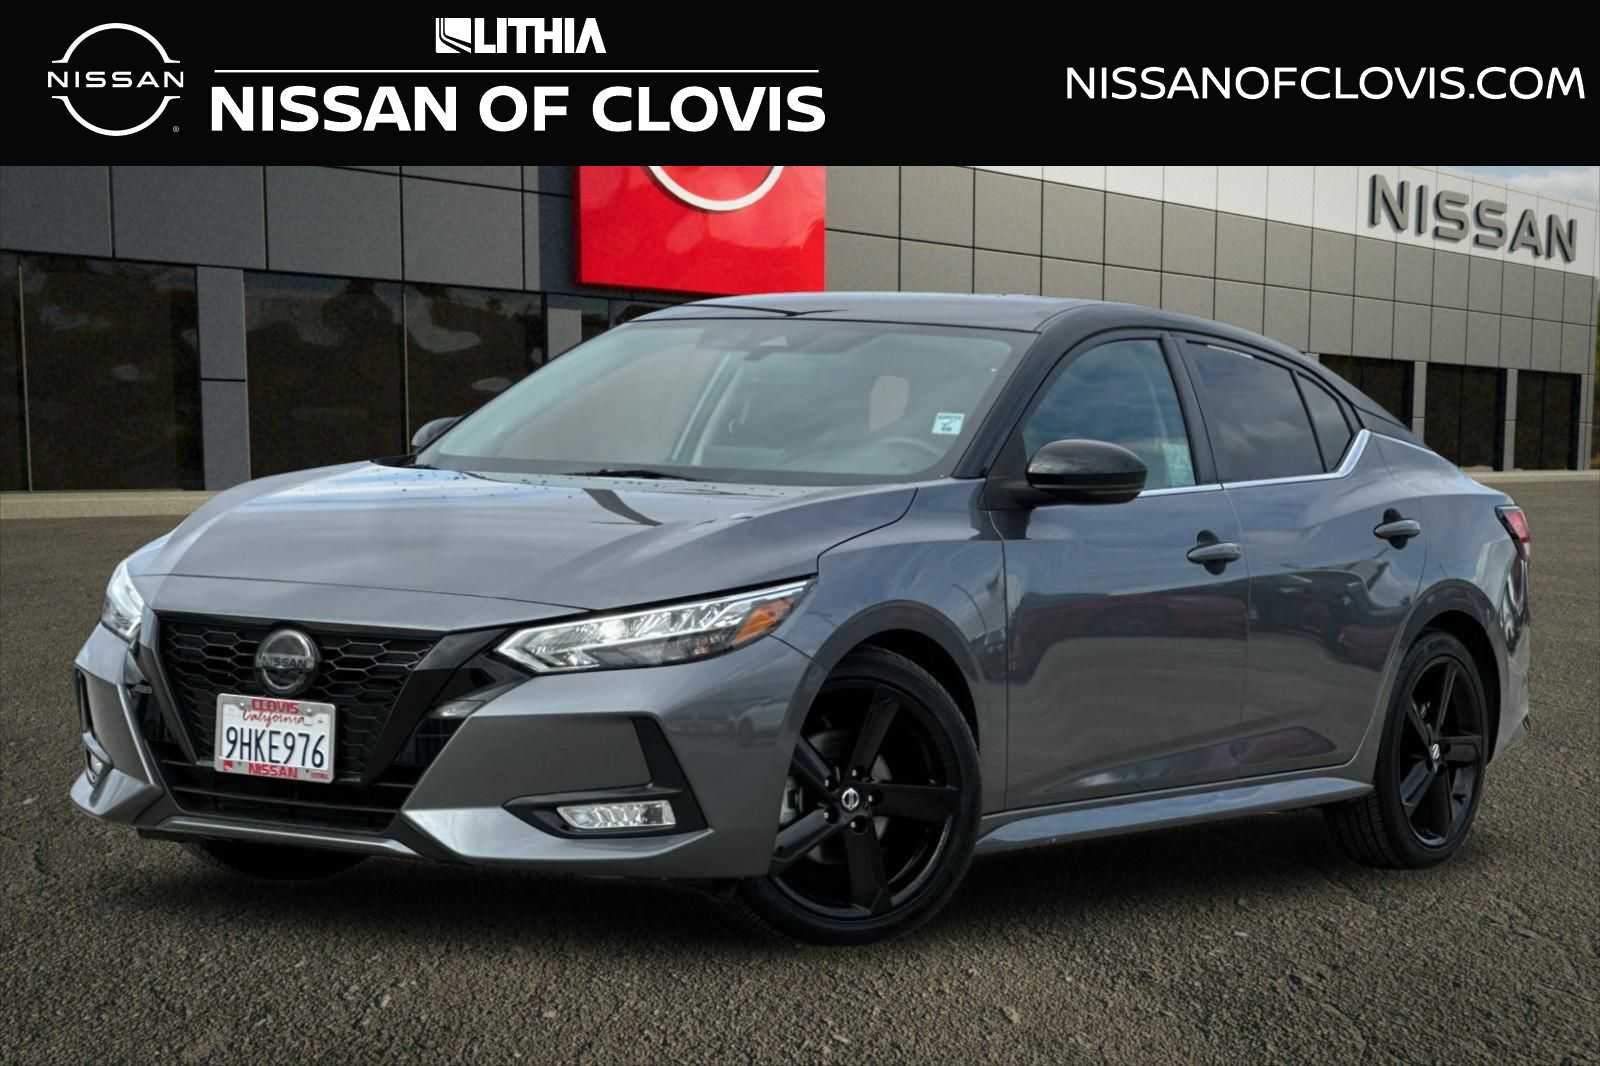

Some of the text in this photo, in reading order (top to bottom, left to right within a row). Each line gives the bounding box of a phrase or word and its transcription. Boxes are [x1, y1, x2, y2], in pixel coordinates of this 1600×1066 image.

[1368, 174, 1577, 263] NISSAN
[263, 655, 307, 669] NISSAN
[225, 726, 325, 768] 9HKE976
[248, 762, 298, 779] NISSAN
